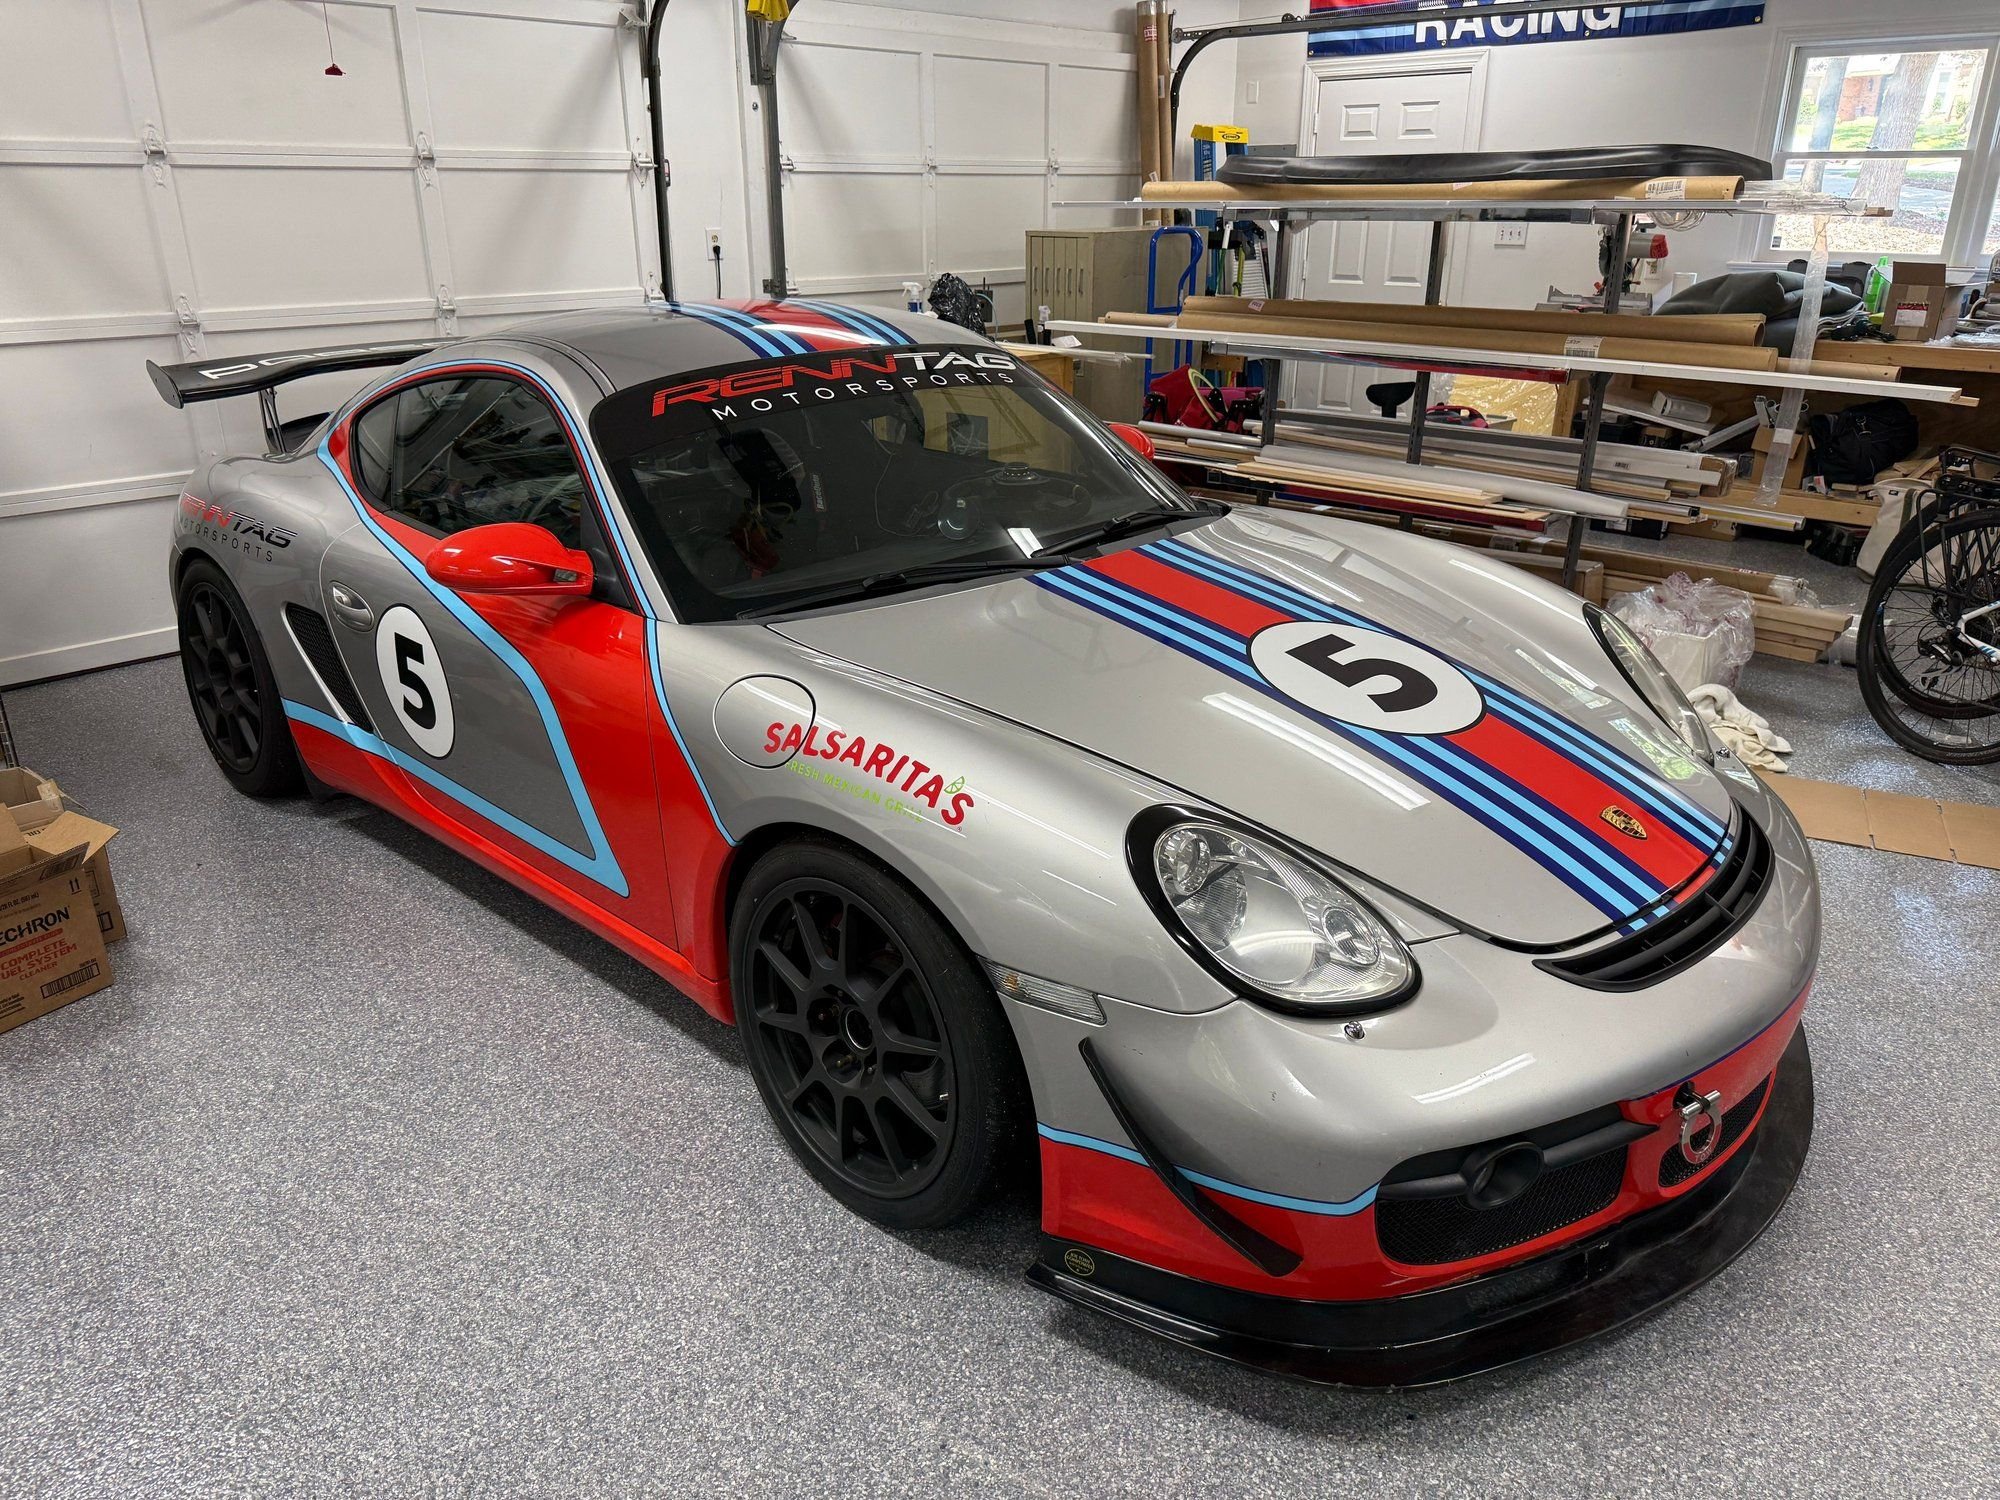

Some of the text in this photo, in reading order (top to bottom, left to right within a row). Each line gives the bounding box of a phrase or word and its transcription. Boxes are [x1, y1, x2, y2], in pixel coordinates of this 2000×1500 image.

[1415, 0, 1622, 43] RACING
[712, 372, 1014, 422] MOTORSPORTS
[394, 632, 437, 730] 5
[1284, 633, 1438, 713] 5
[822, 773, 882, 805] MEXICAN
[884, 797, 924, 824] GRILL
[0, 907, 70, 946] ECHRON
[1, 938, 68, 970] COMPLETE
[1, 963, 26, 980] UEL
[27, 943, 77, 969] SYSTEM
[19, 961, 58, 981] CLEANER
